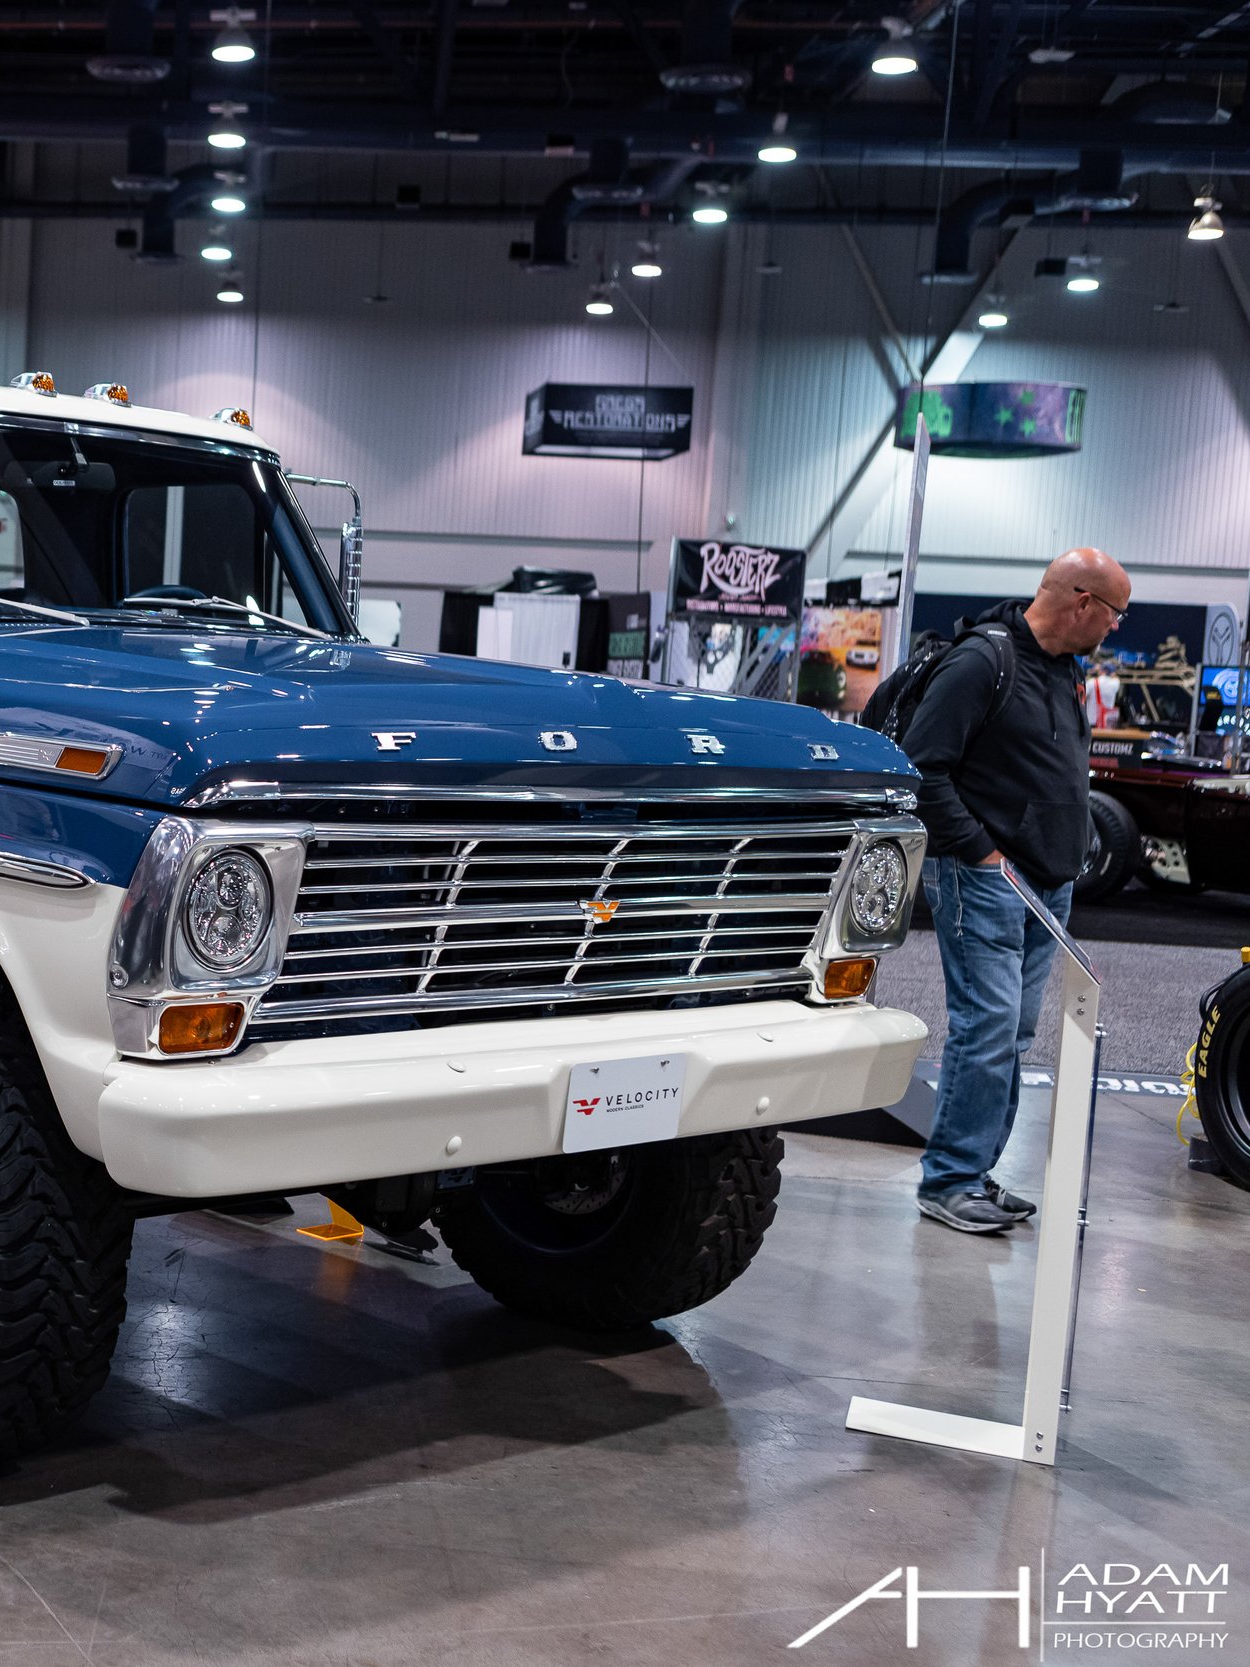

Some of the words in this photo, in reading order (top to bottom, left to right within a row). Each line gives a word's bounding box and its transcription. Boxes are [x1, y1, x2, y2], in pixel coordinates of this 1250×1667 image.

[370, 731, 839, 761] FORD
[1092, 741, 1133, 756] CUSTOMZ
[1198, 1005, 1221, 1078] EAGLE
[606, 1087, 679, 1106] VELOCITY
